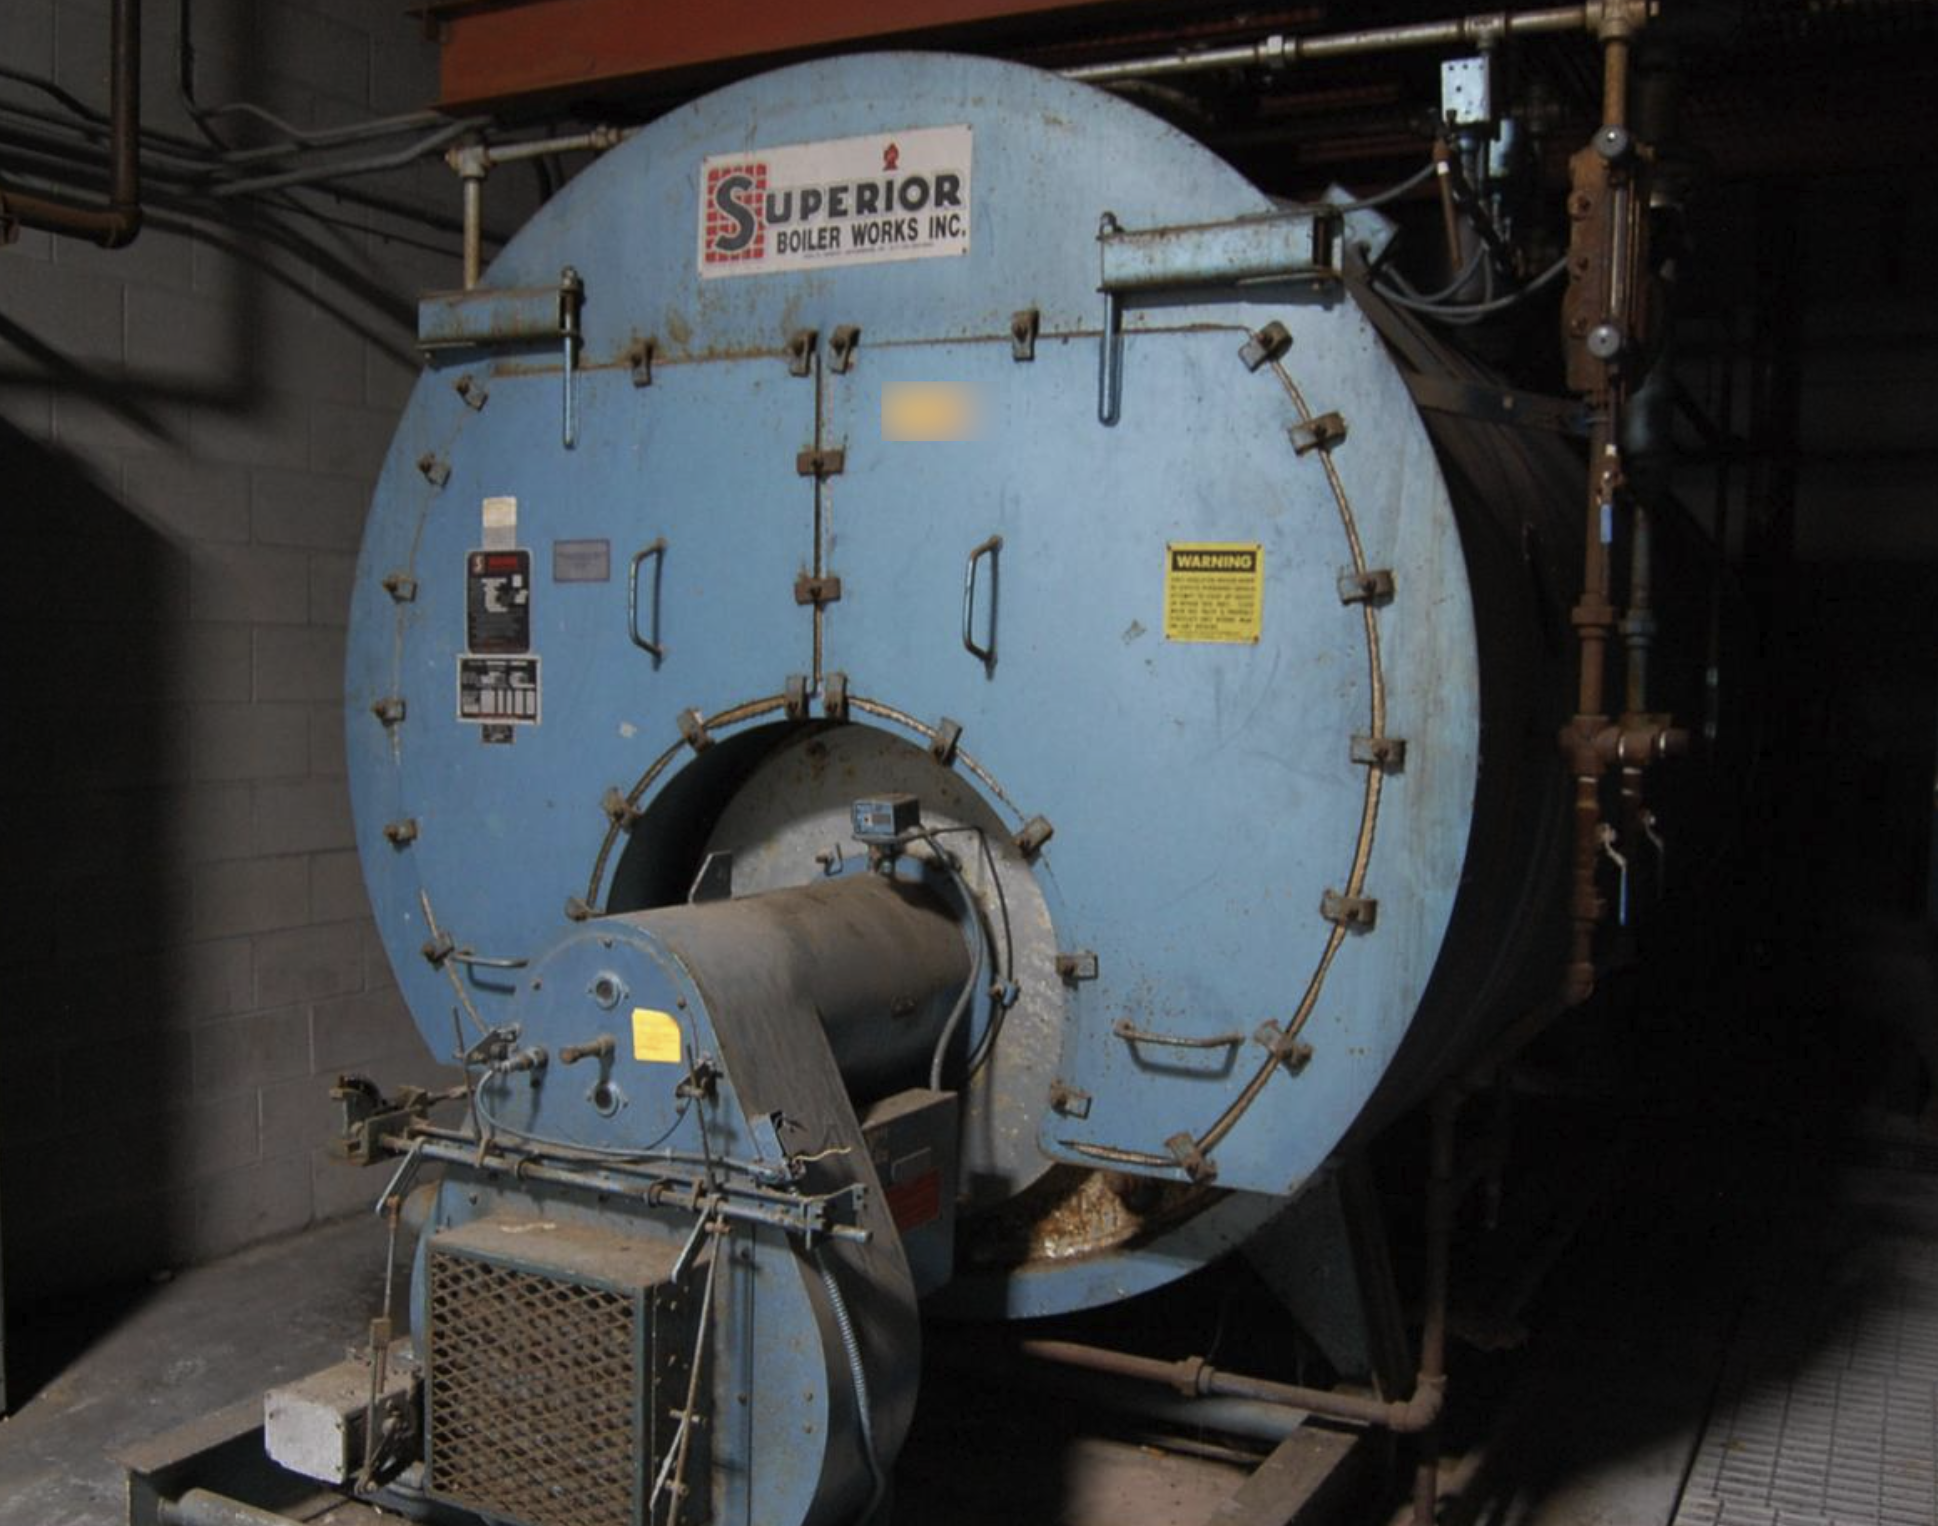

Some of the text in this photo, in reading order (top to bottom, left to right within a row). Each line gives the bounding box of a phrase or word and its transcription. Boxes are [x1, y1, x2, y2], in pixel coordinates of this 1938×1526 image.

[715, 173, 961, 252] SUPERIOR
[776, 225, 841, 254] BOILER
[851, 219, 918, 248] WORKS
[929, 214, 966, 239] INC.
[1176, 554, 1252, 568] WARNING
